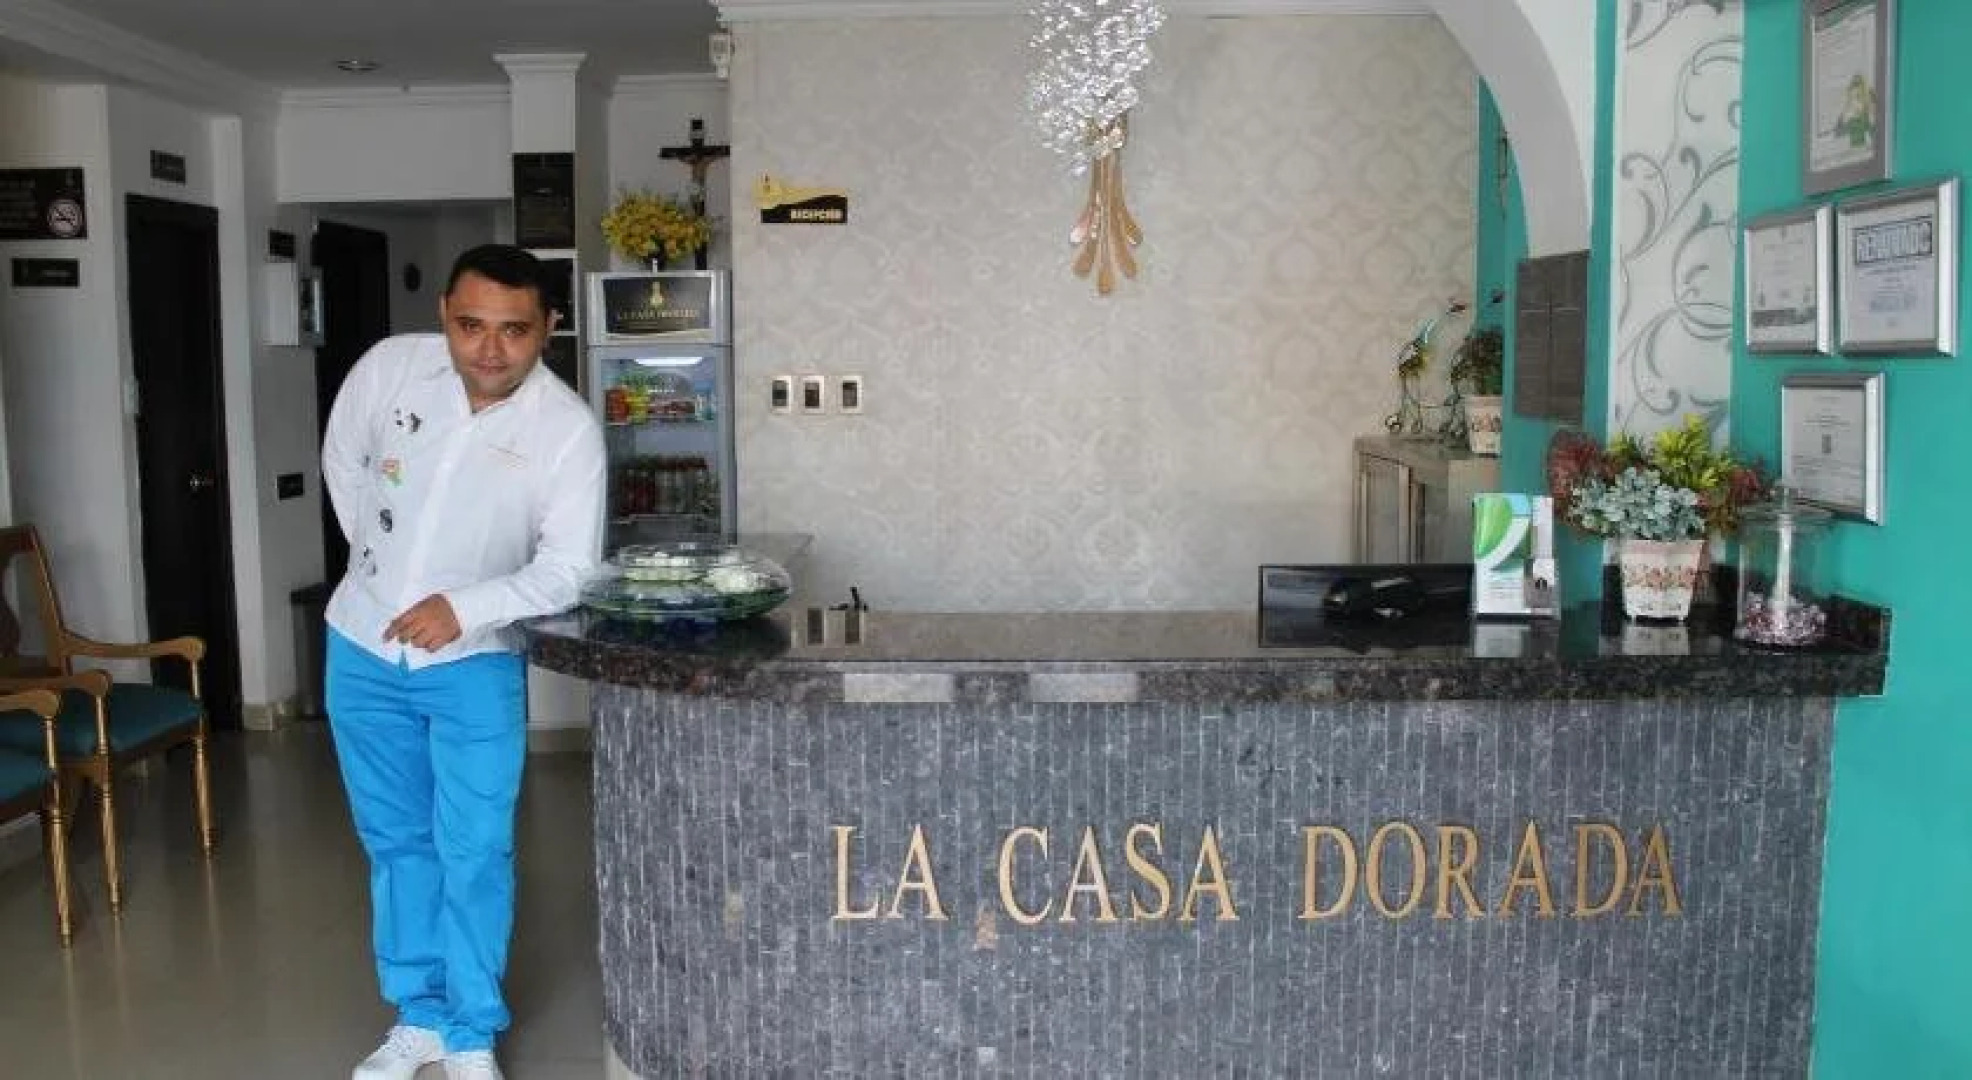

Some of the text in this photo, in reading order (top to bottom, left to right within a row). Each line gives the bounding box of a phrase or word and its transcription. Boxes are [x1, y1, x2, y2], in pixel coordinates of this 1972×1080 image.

[830, 820, 1682, 924] LA CASA DORADA
